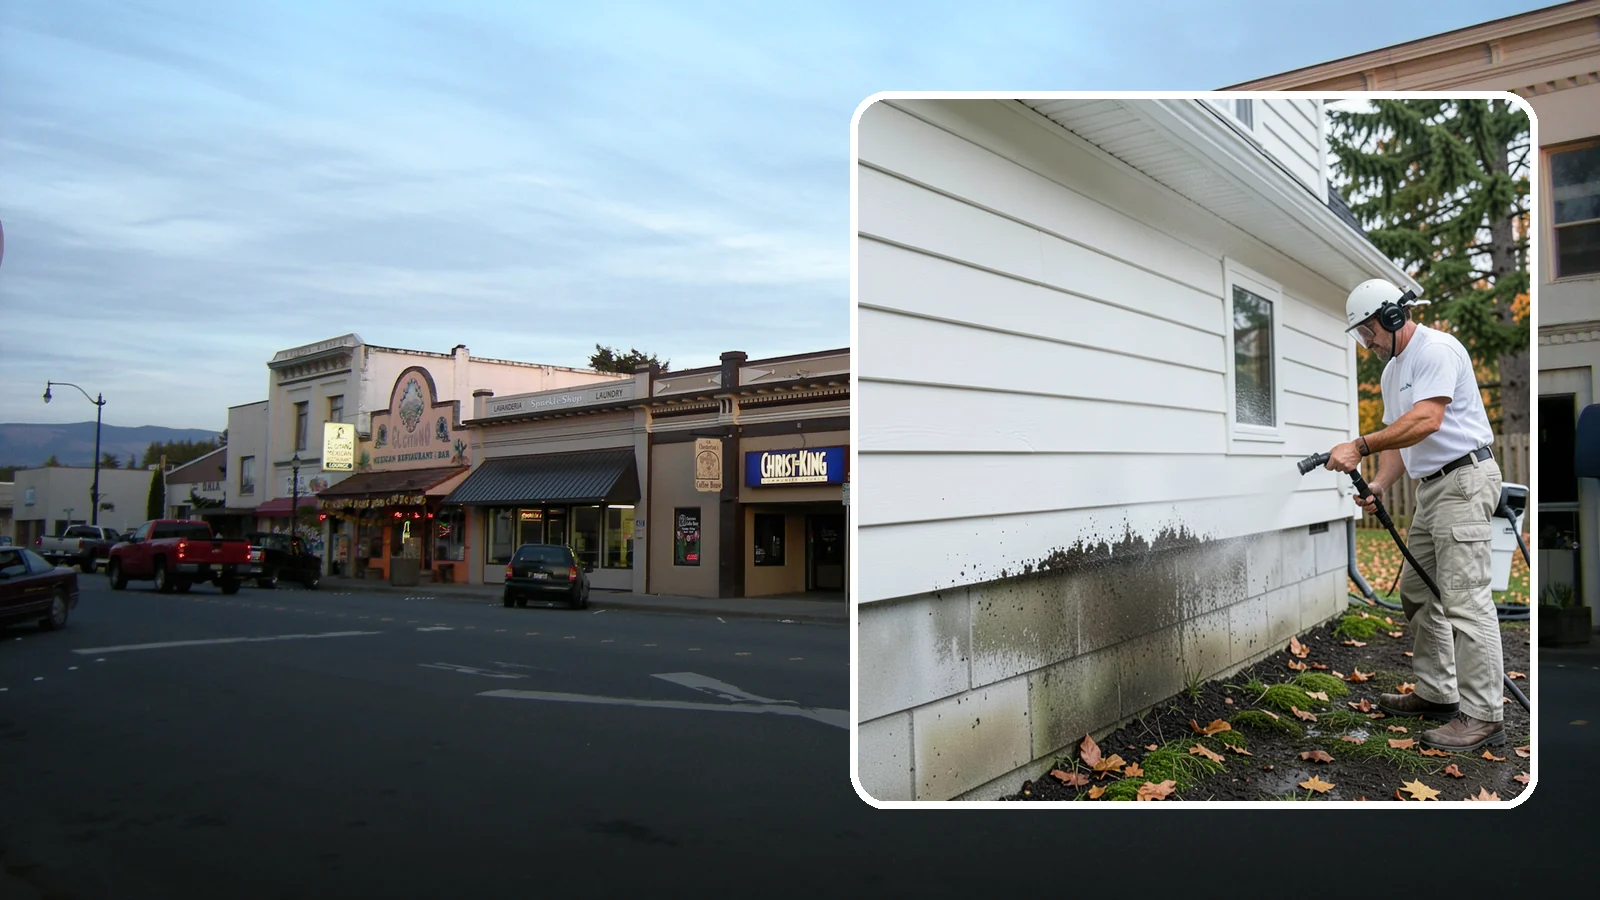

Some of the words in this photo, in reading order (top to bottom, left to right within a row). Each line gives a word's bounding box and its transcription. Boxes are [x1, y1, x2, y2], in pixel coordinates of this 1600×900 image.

[596, 389, 623, 399] LAUNDRY
[493, 402, 522, 413] LAVANDERIA
[531, 398, 560, 409] Sparkle
[561, 394, 582, 405] Shop
[374, 454, 396, 464] MEXICAN
[397, 451, 433, 463] RESTAURANT
[437, 450, 450, 459] BAR
[761, 452, 797, 478] CHRIST
[799, 450, 827, 476] KING
[696, 480, 709, 488] Coffee
[710, 480, 722, 488] House
